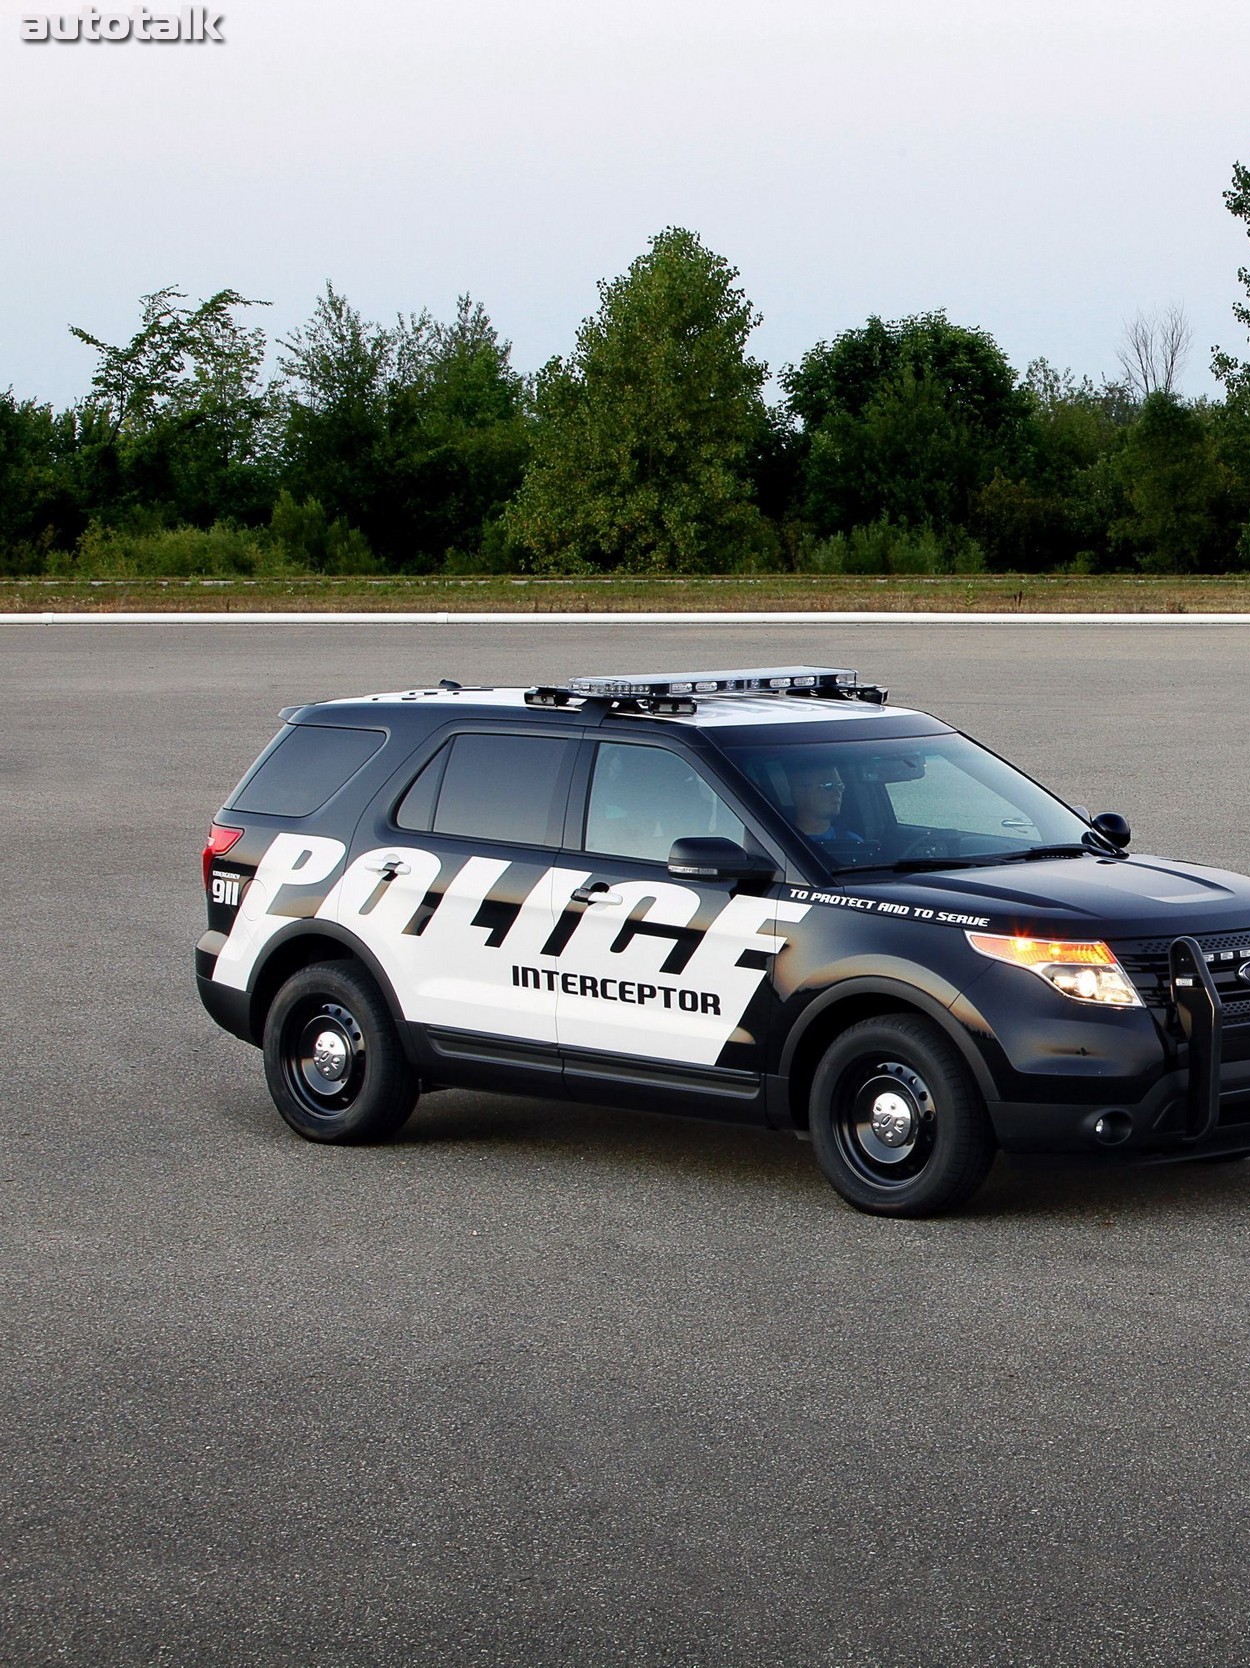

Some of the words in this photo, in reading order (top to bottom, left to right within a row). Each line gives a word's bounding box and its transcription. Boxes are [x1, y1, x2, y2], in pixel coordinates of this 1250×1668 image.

[212, 878, 240, 906] 911
[224, 832, 813, 982] POLICE
[790, 888, 809, 900] TO
[810, 892, 877, 910] PROTECT
[877, 902, 910, 916] AND
[913, 907, 934, 919] TO
[936, 911, 991, 927] SERVE
[511, 965, 722, 1016] INTERCEPTOR
